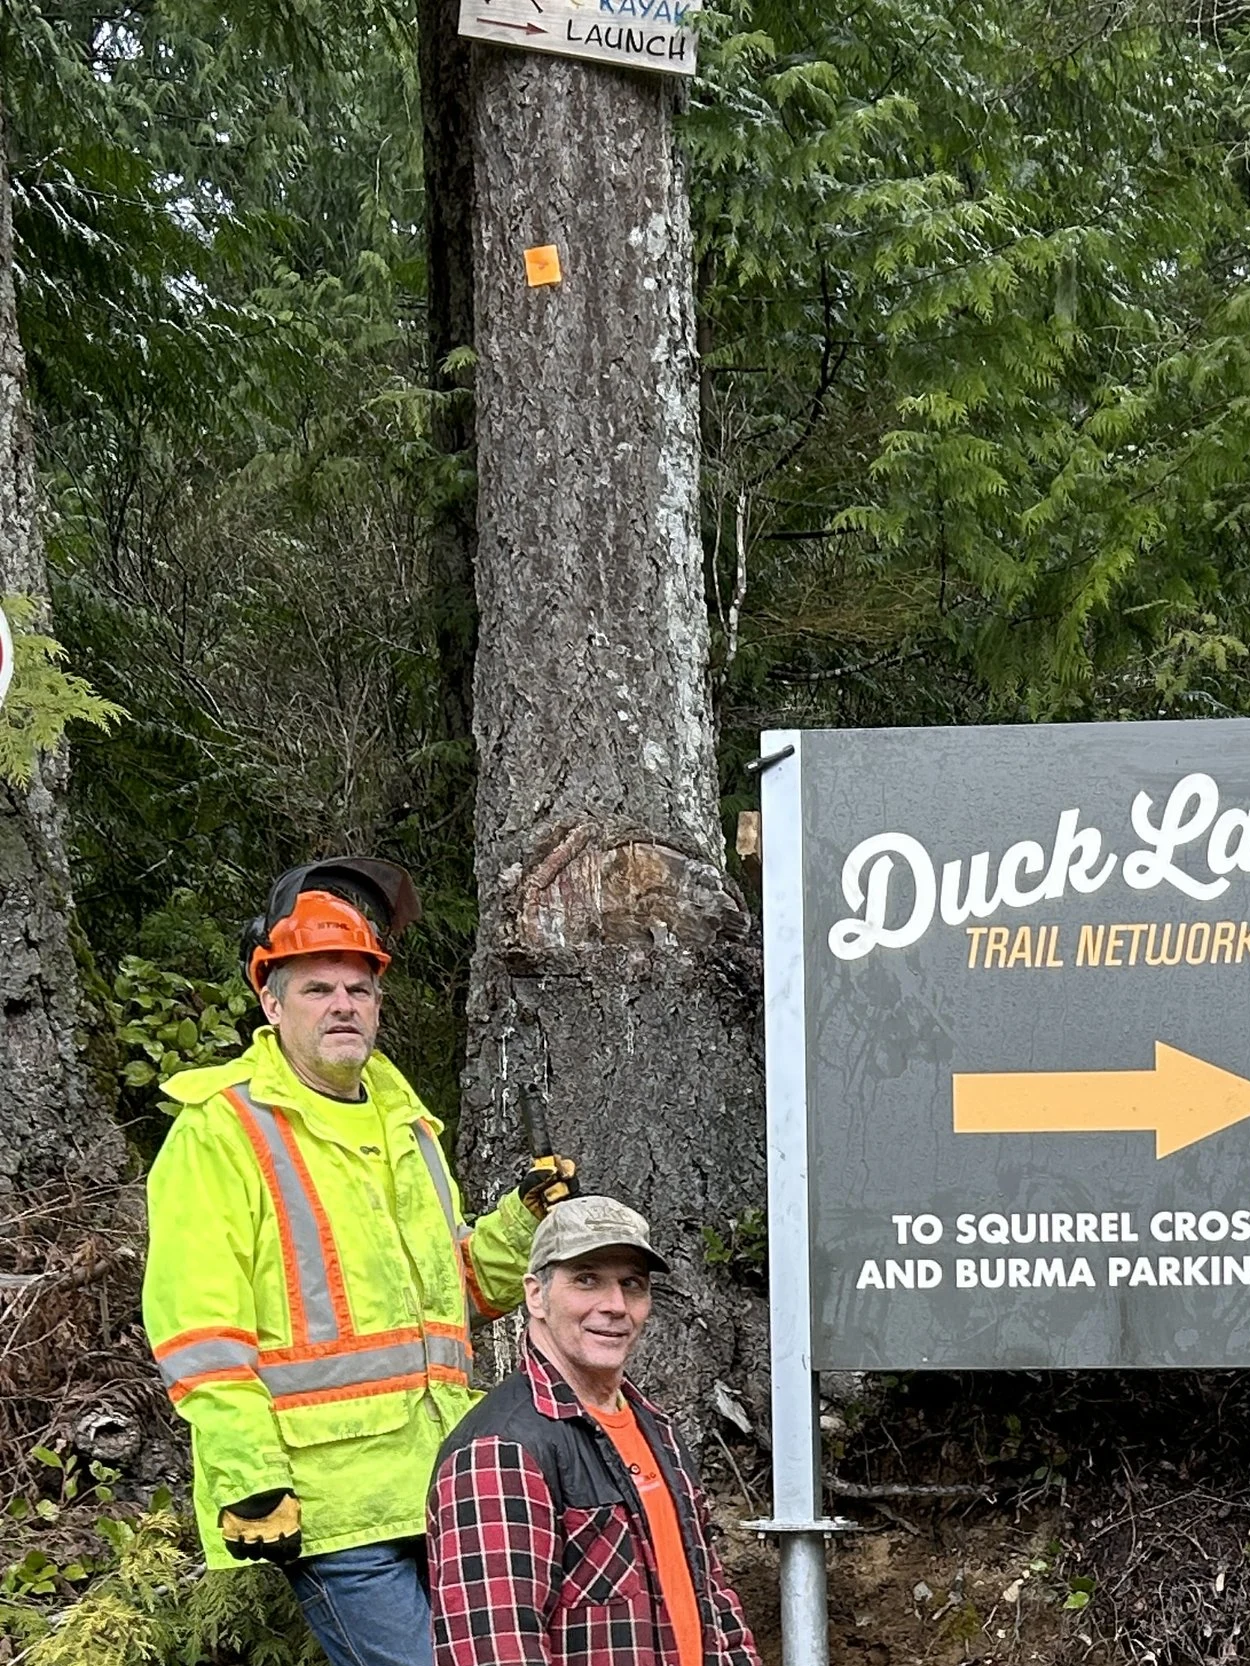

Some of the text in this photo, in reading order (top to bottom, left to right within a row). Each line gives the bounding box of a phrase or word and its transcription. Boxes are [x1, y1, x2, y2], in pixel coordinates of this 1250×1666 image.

[566, 19, 686, 60] LAUNCH
[828, 808, 1119, 961] Duck
[966, 924, 1064, 969] TRAIL
[892, 1213, 944, 1245] TO
[956, 1212, 1139, 1245] SQUIRREL
[856, 1258, 943, 1290] AND
[956, 1257, 1096, 1289] BURMA
